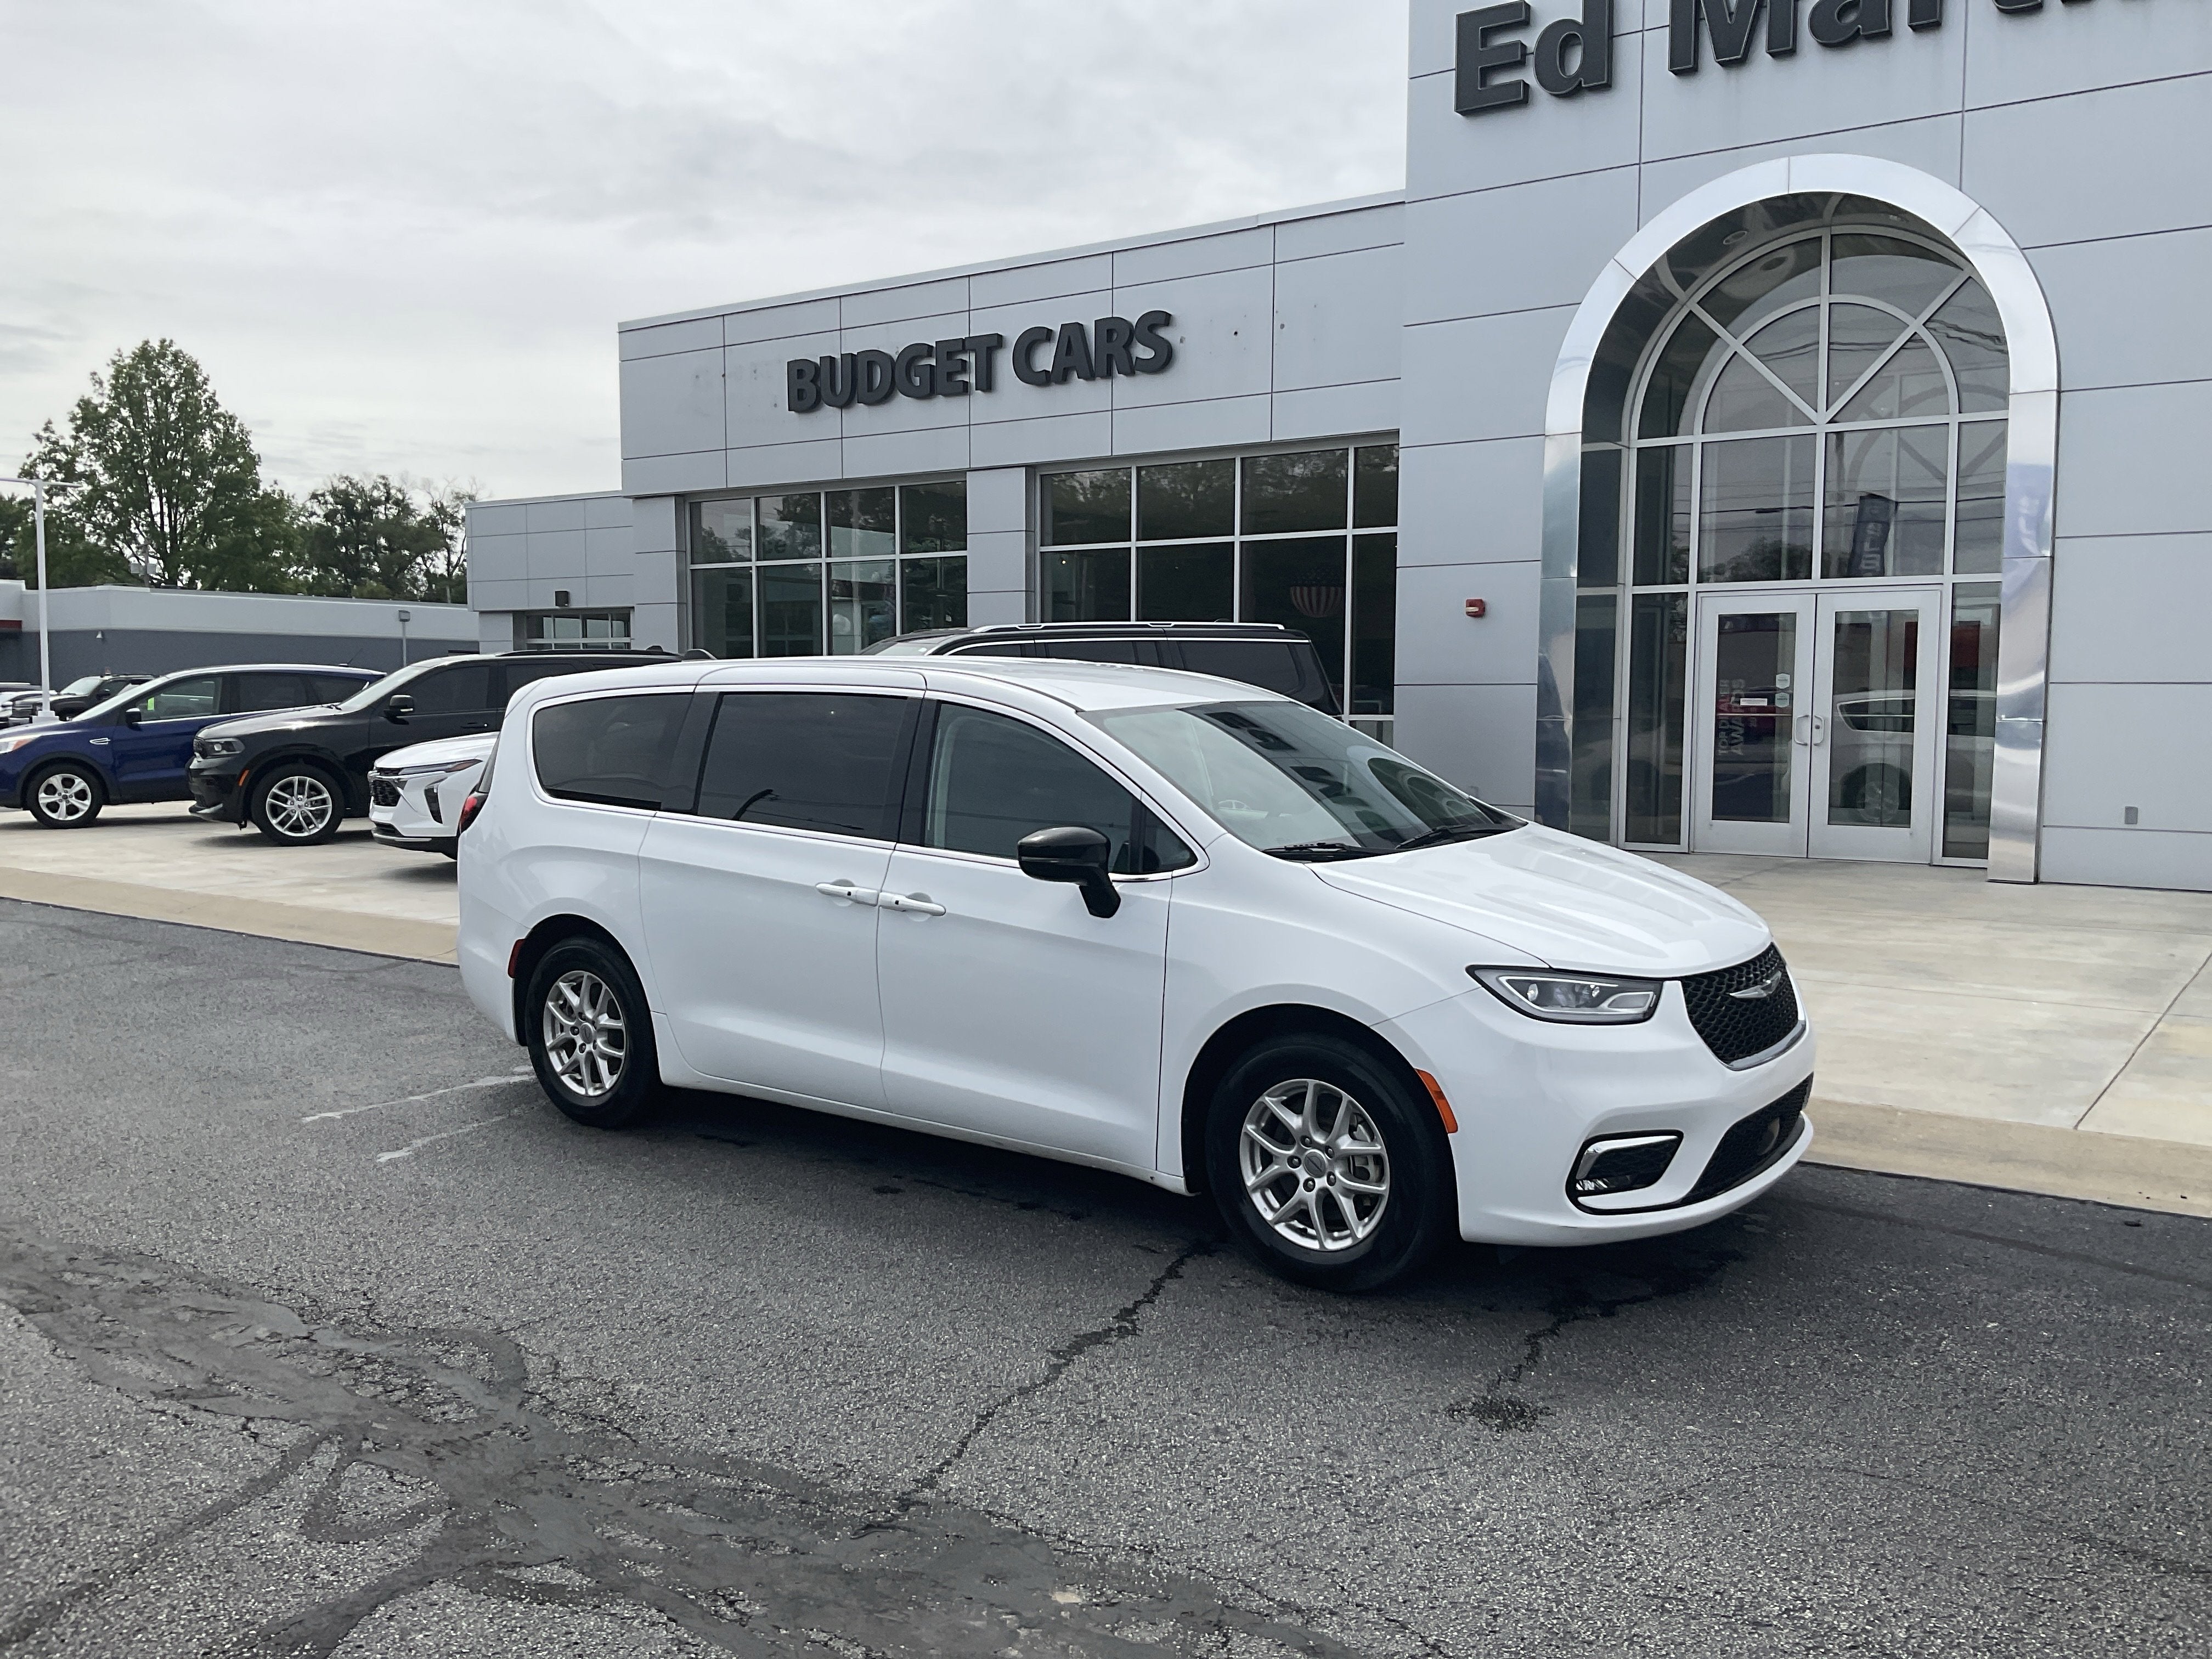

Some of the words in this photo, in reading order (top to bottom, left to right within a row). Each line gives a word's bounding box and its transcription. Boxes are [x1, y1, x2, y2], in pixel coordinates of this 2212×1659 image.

[1455, 0, 1613, 115] Ed
[788, 333, 1003, 413] BUDGET
[1012, 310, 1173, 386] CARS
